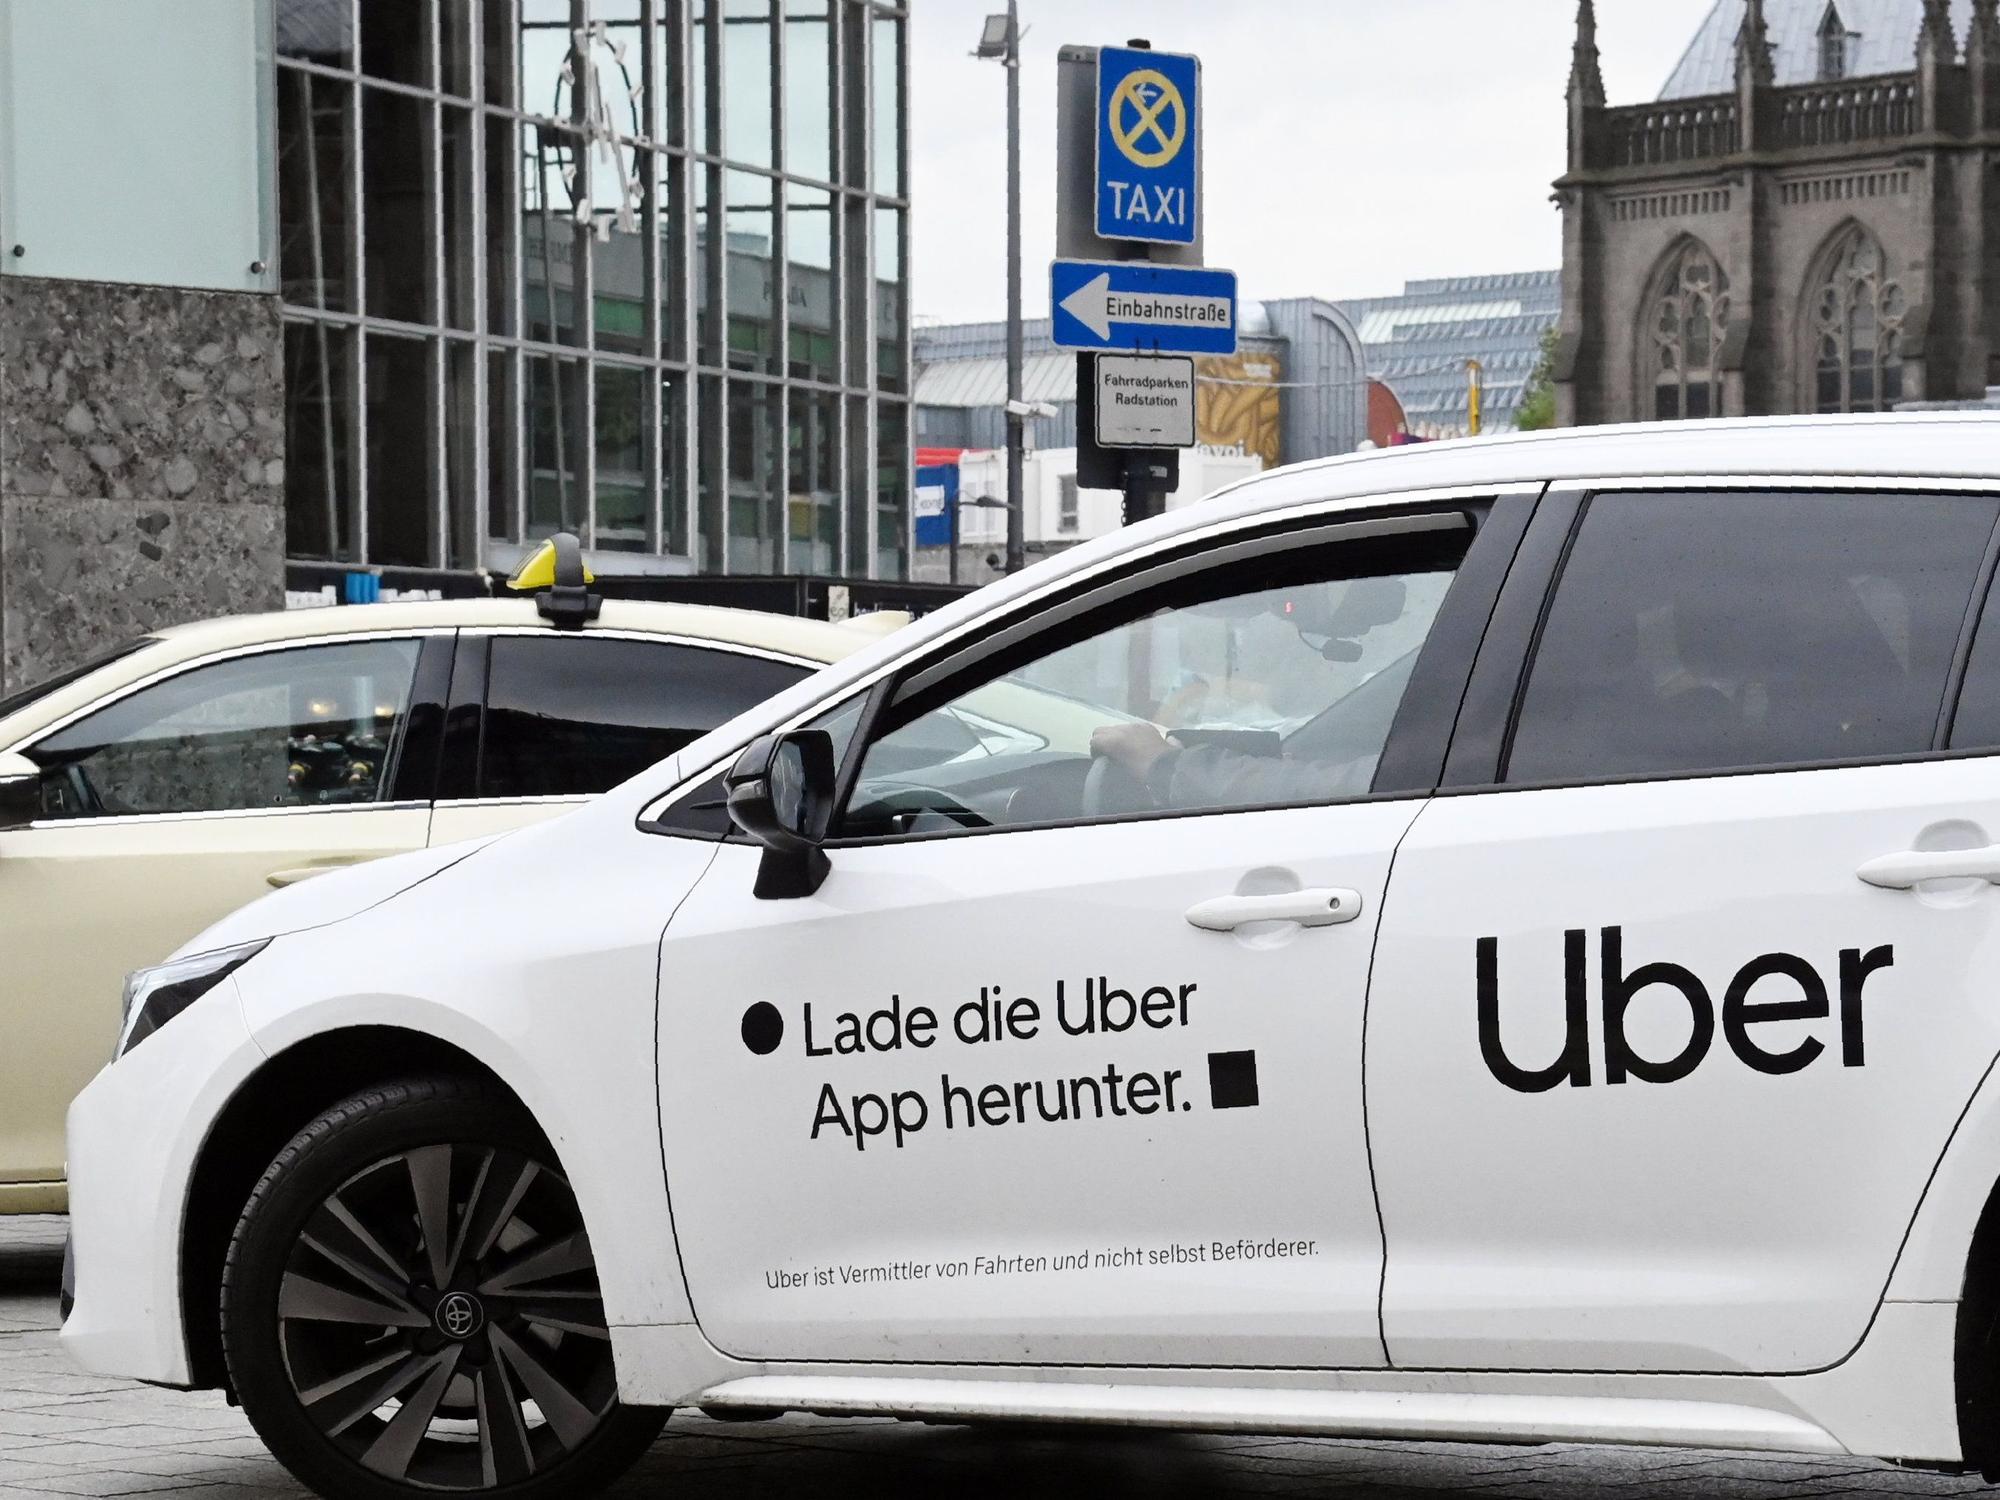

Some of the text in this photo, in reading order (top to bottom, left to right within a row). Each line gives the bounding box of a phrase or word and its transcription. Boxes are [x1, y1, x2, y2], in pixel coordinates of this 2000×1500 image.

[1107, 181, 1186, 225] TAXI
[1106, 297, 1228, 323] Einbahnstraße
[1104, 373, 1189, 391] Fahrradparken
[1115, 392, 1178, 408] Radstation
[803, 976, 1198, 1057] Lade die Uber
[1477, 926, 1894, 1094] Uber
[810, 1063, 1193, 1152] App herunter.
[765, 1236, 1319, 1290] Uber ist Vermittler von Fahrten und nicht selbst Beförderer.
